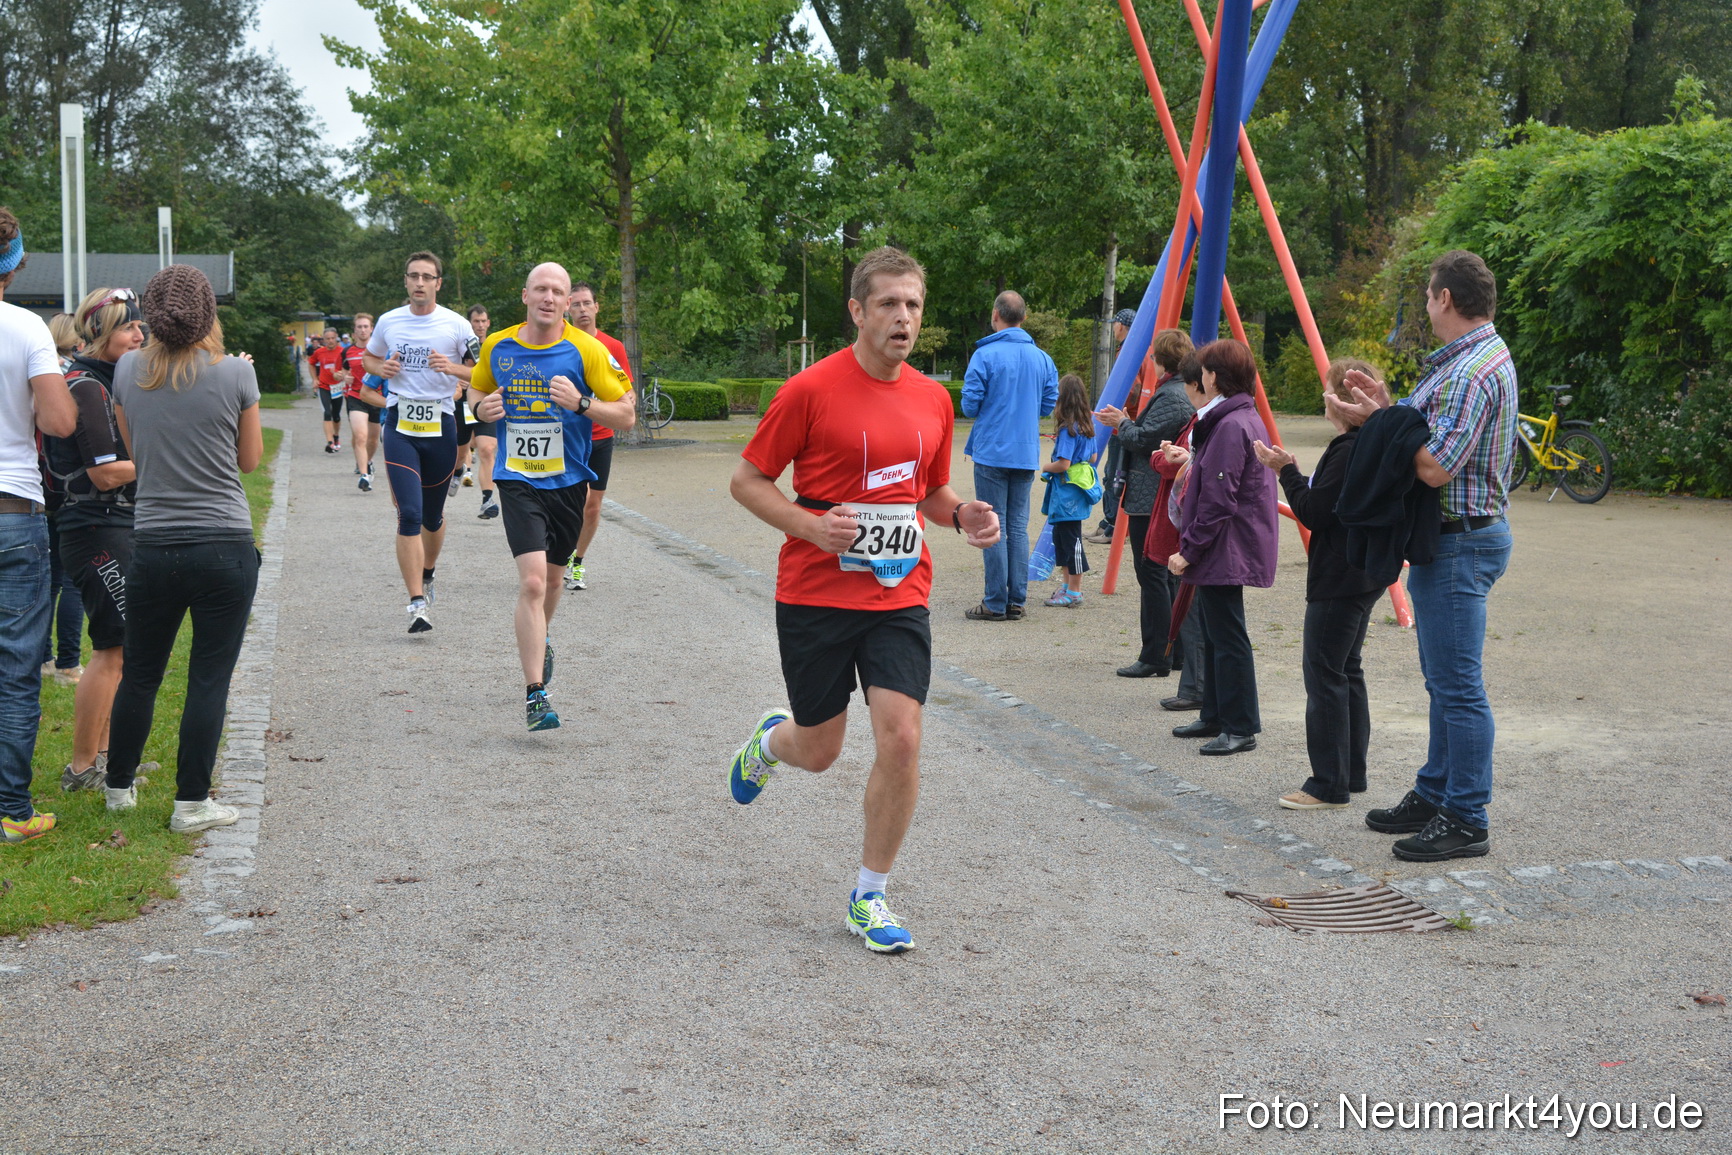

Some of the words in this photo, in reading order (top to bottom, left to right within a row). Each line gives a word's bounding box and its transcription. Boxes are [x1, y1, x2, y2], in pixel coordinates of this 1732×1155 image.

[399, 356, 428, 365] Mülle
[406, 404, 433, 421] 295
[515, 436, 551, 457] 267
[523, 461, 545, 471] Silvio
[881, 468, 903, 481] DEHN
[848, 524, 918, 556] 2340
